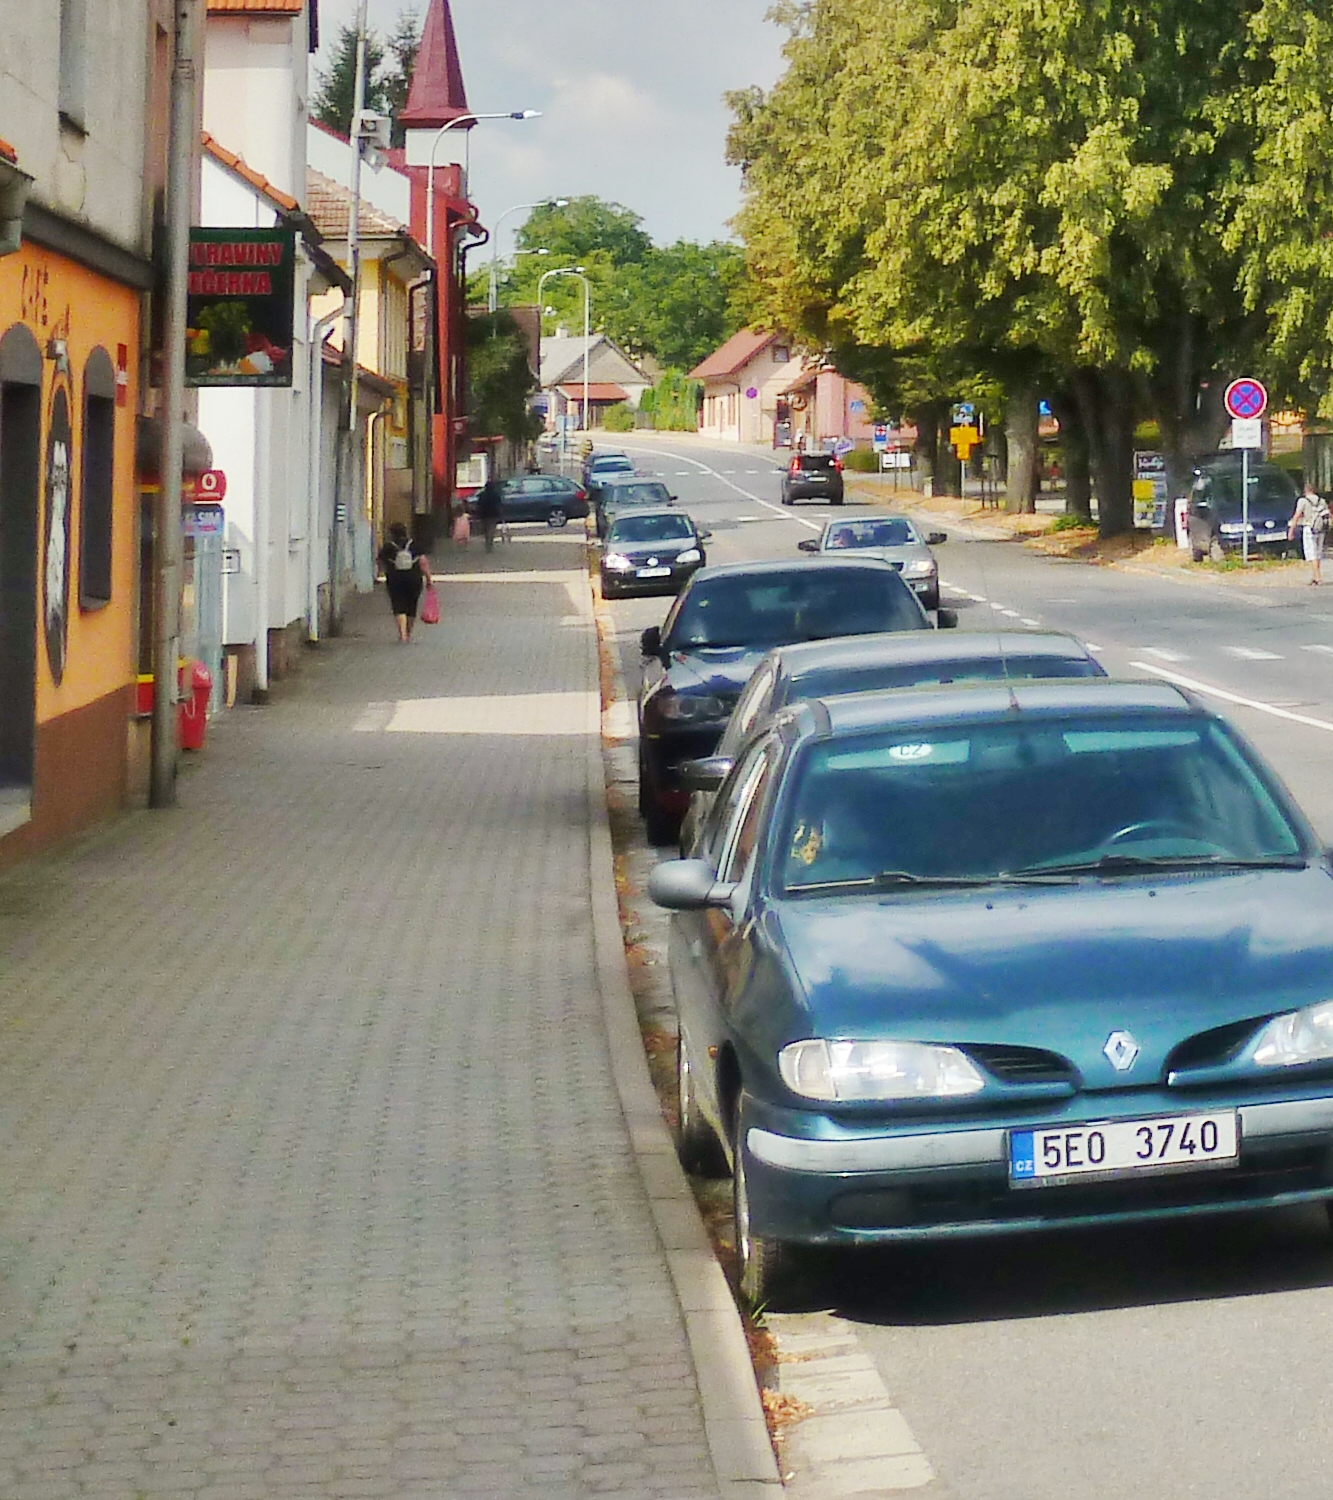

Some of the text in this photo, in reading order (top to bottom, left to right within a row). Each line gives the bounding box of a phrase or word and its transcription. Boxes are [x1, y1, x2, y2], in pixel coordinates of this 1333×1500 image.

[1016, 1120, 1218, 1172] CZ 5E0 3740
